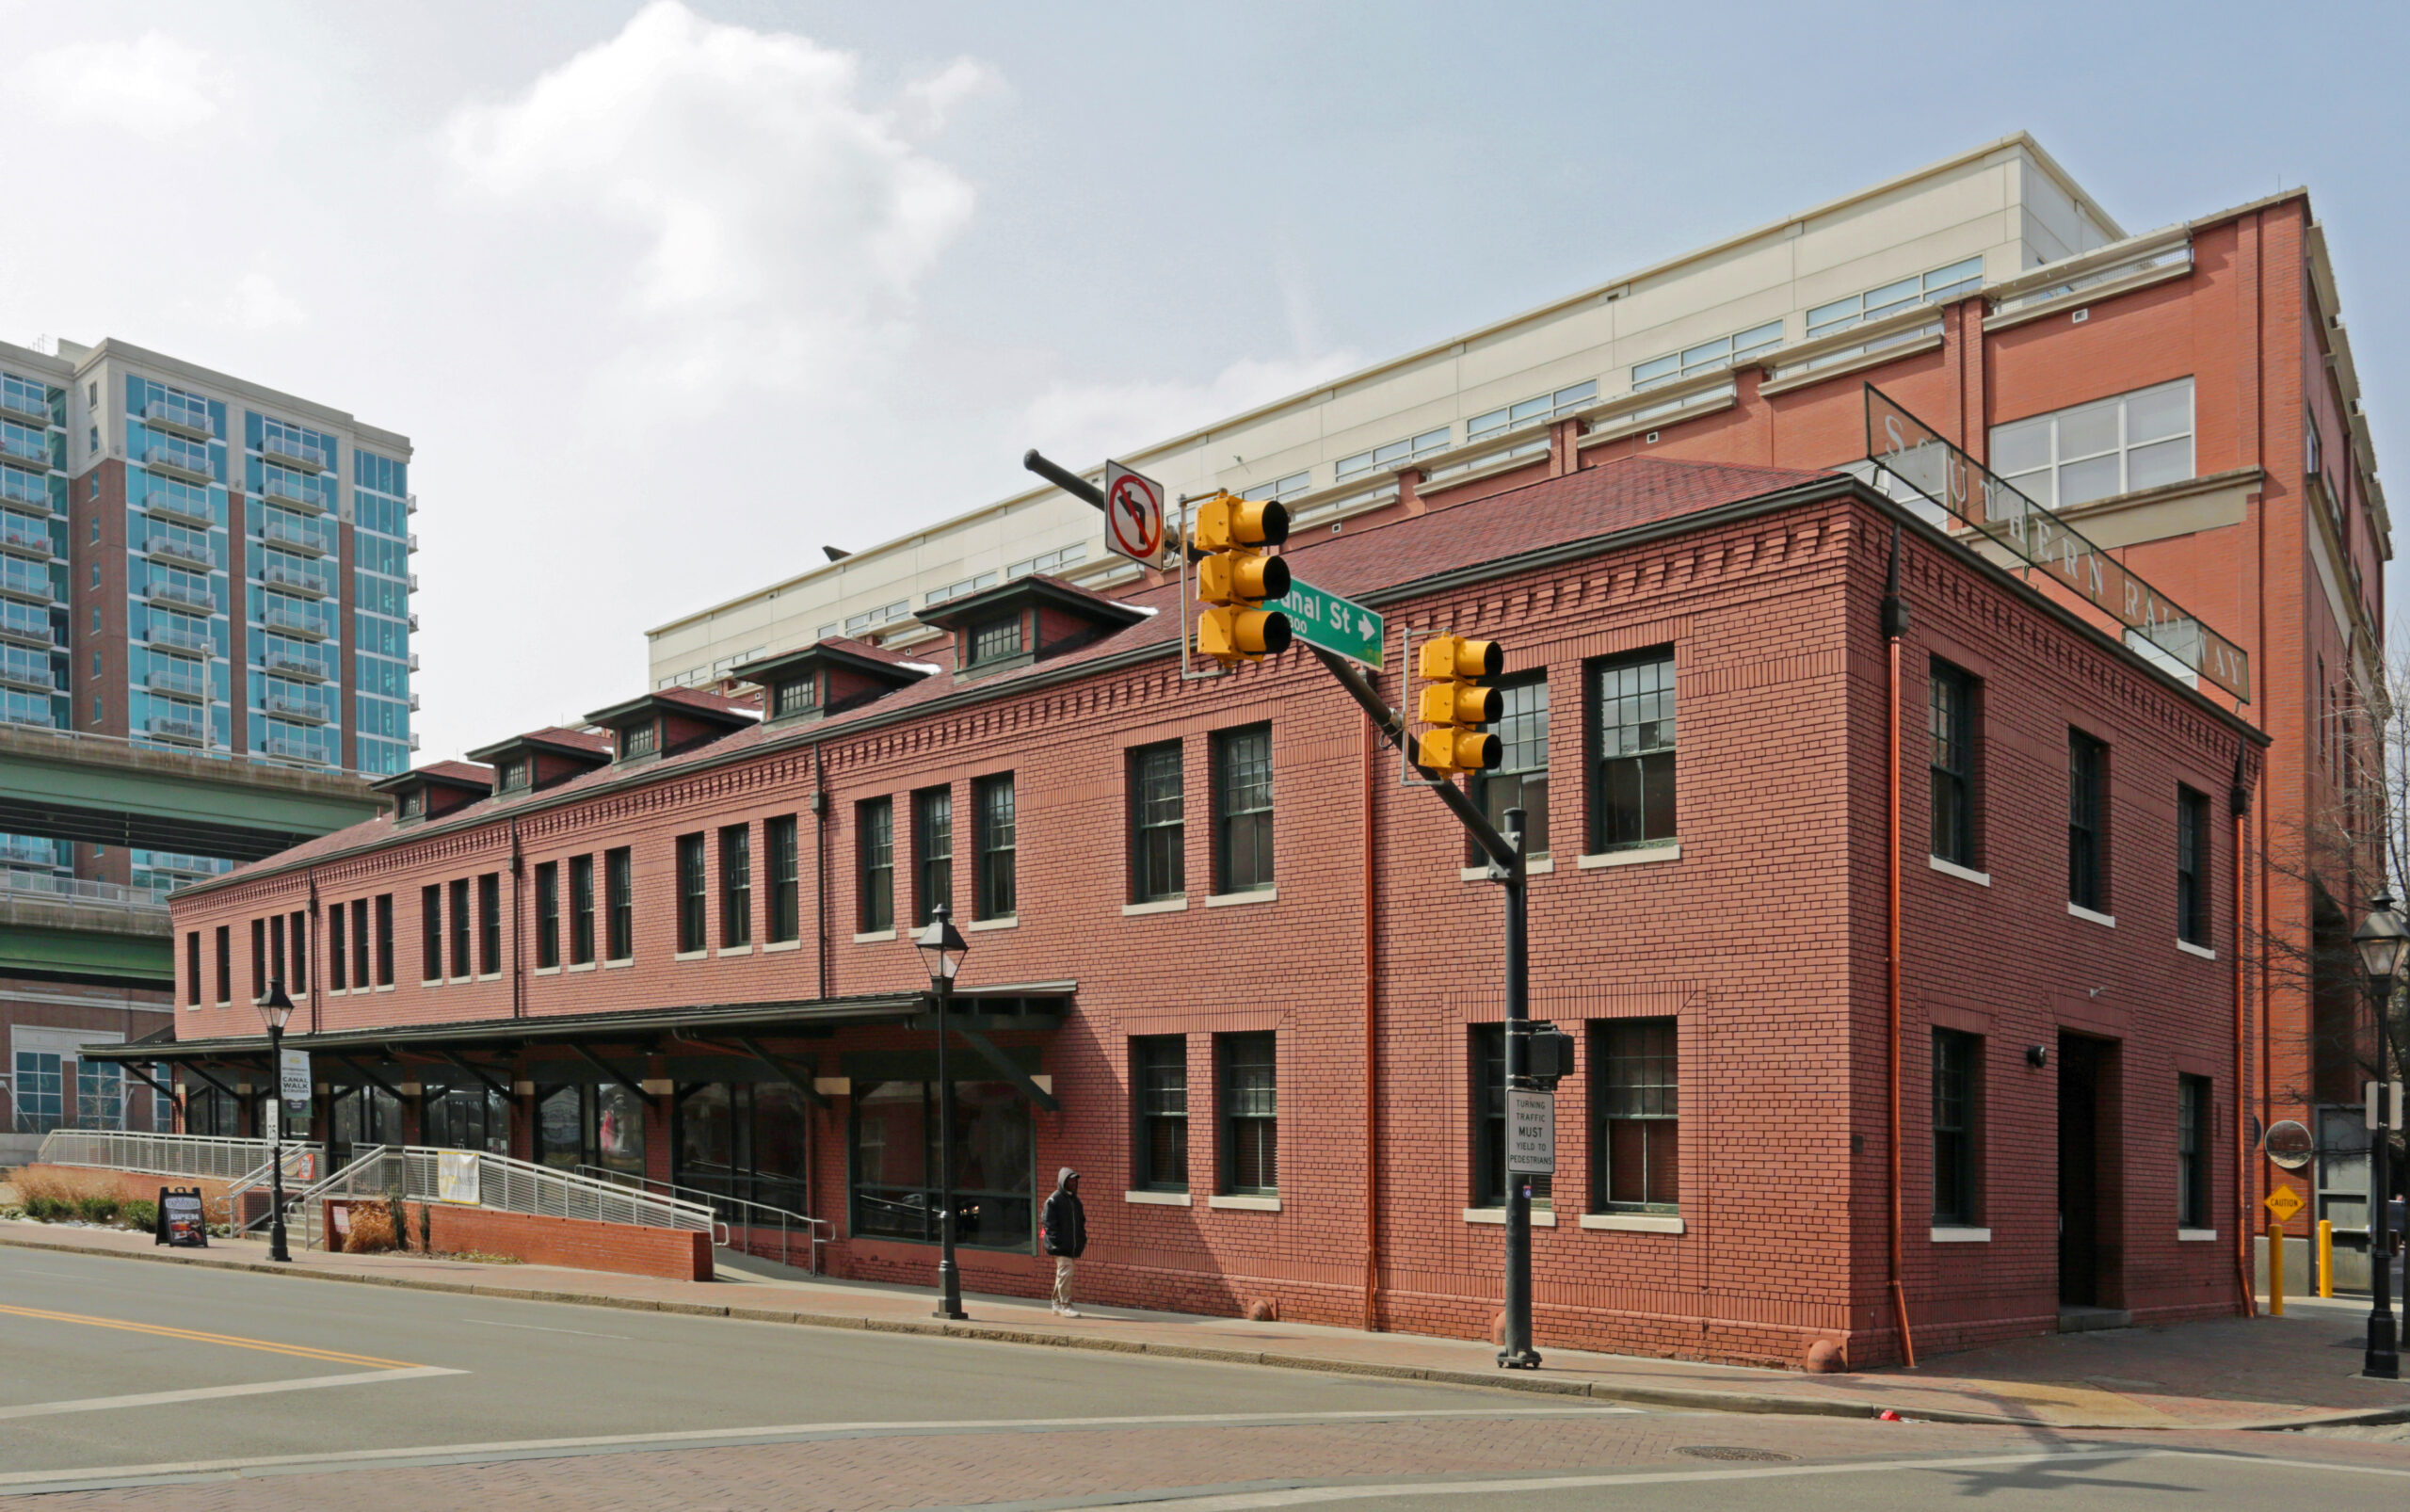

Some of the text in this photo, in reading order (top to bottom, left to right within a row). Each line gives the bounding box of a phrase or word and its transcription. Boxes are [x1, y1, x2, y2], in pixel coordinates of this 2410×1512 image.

[1271, 589, 1351, 635] anal St
[1284, 613, 1308, 635] 300
[282, 1082, 309, 1090] WALK
[1517, 1099, 1546, 1110] TURNING
[1517, 1112, 1546, 1123] TRAFFIC
[1518, 1125, 1543, 1138] MUST
[1517, 1141, 1547, 1152] YIELD TO
[1510, 1154, 1553, 1166] PEDESTRIANS
[2270, 1197, 2298, 1207] CAUTION
